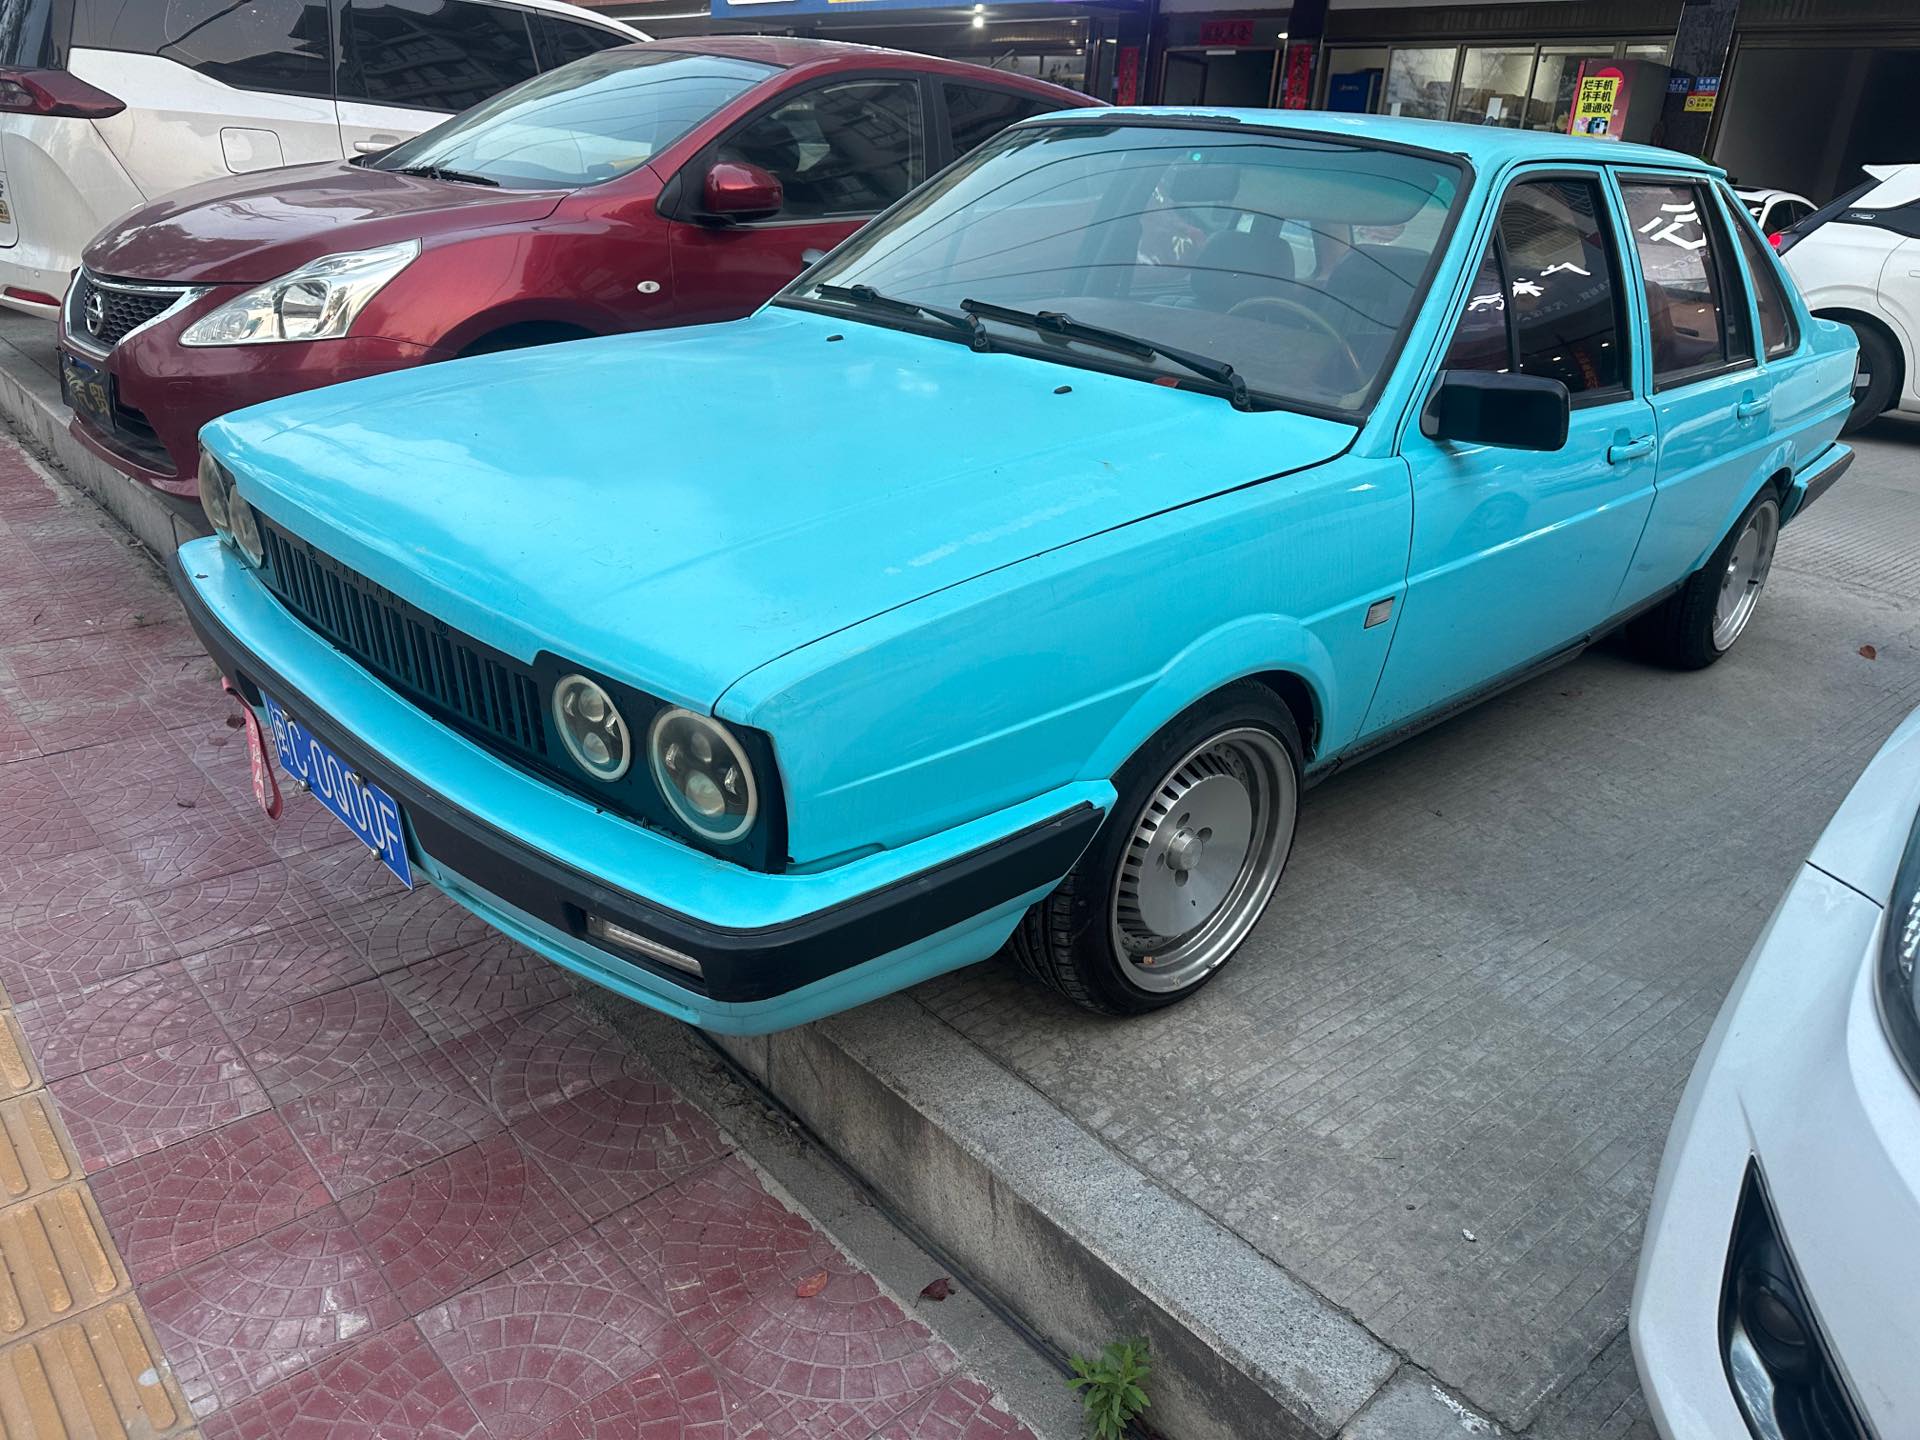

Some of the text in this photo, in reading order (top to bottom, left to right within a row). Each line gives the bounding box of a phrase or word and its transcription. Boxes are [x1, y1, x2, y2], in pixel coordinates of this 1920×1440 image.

[1583, 80, 1613, 91] 烂手机
[1582, 91, 1611, 102] 坏手机
[1582, 103, 1612, 113] 通通收
